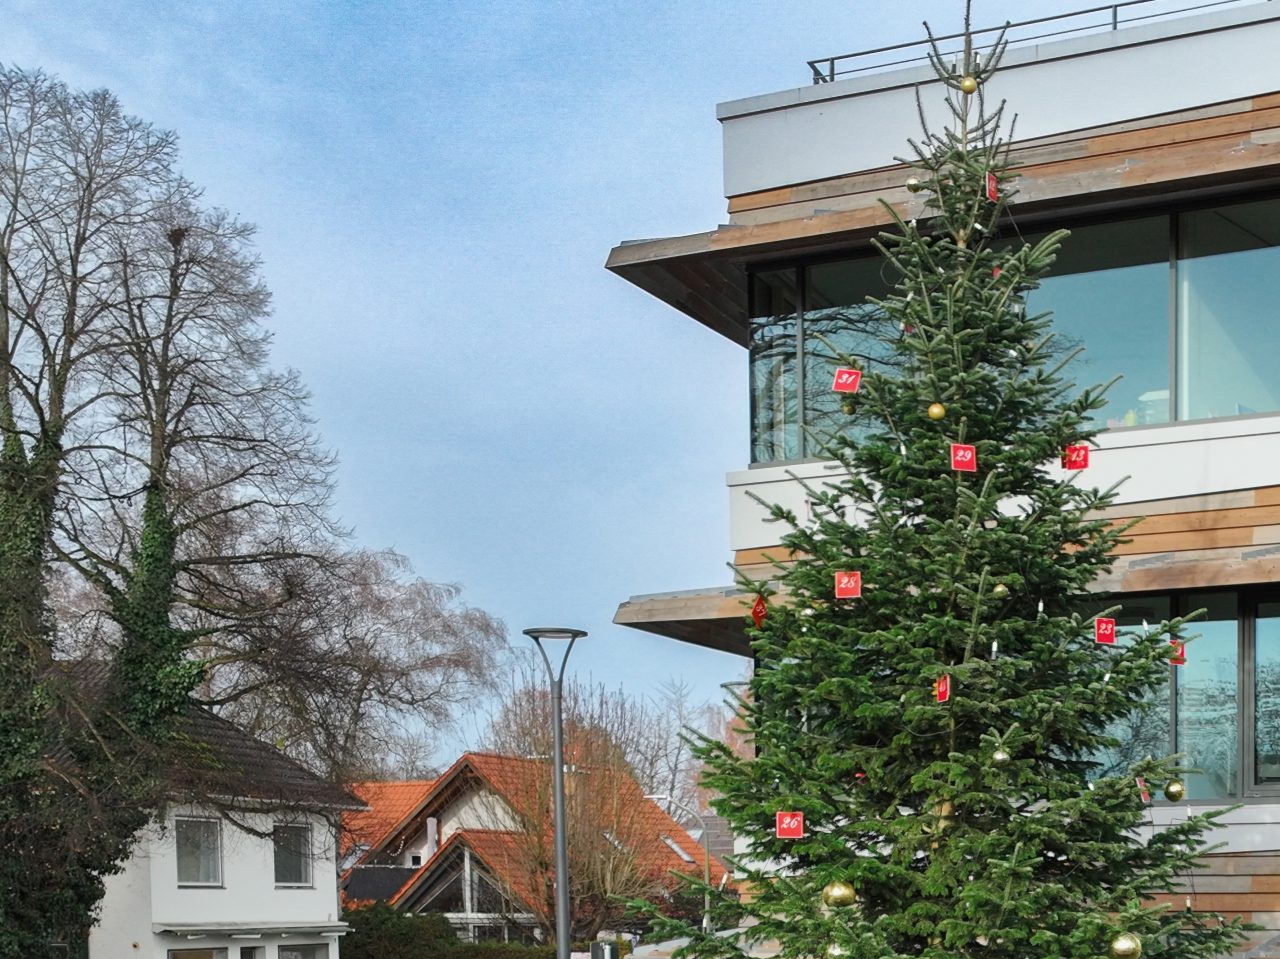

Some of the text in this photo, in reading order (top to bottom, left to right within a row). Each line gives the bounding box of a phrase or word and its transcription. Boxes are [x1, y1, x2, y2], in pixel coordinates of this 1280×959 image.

[838, 373, 857, 384] 31
[955, 449, 972, 461] 29
[839, 576, 857, 588] 28
[1098, 623, 1113, 634] 23
[781, 817, 800, 829] 26
